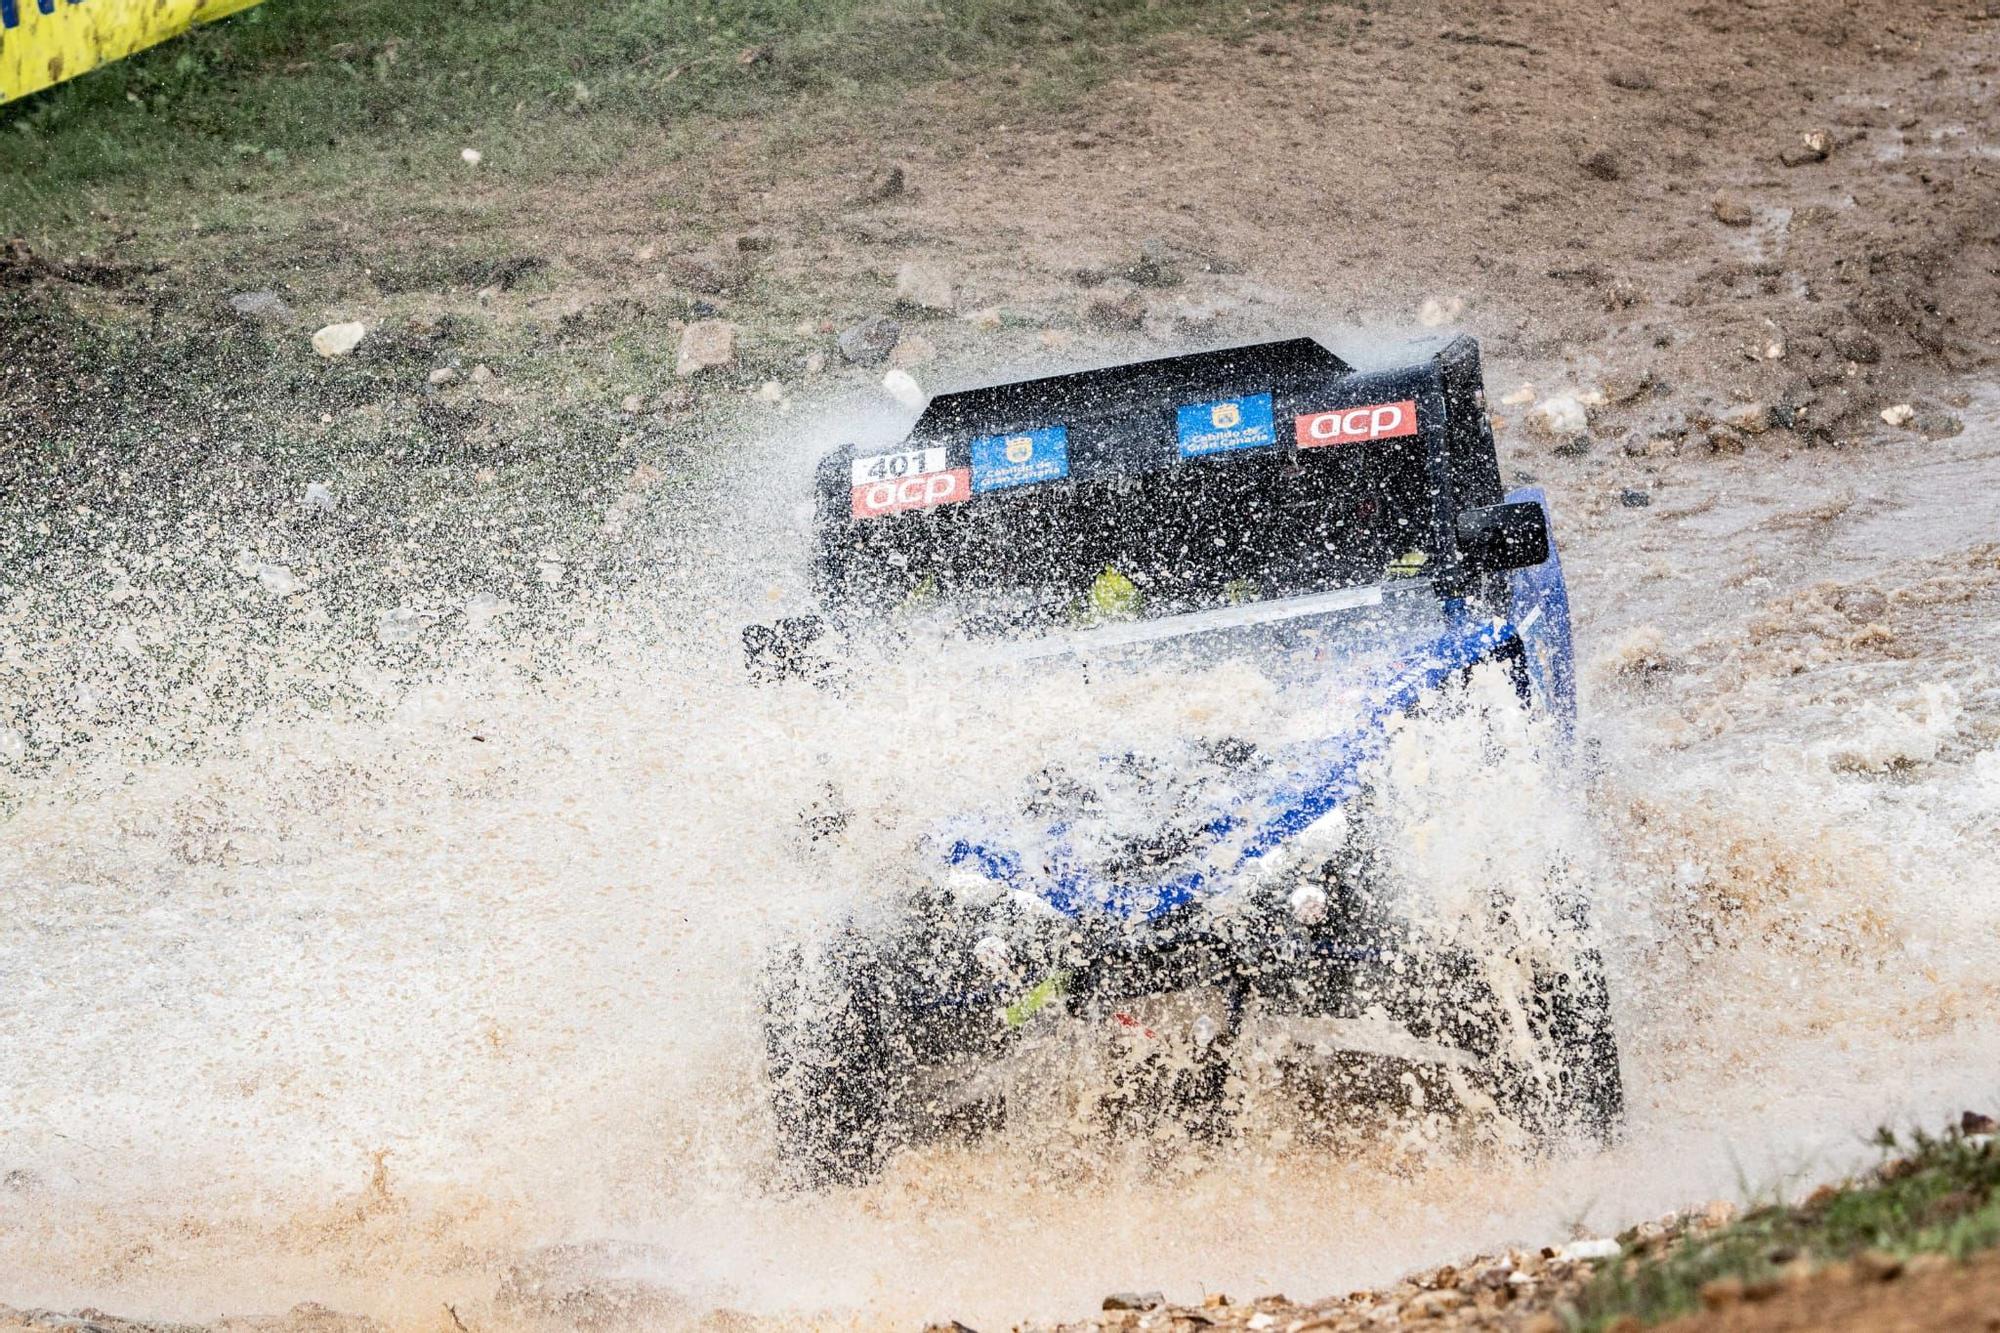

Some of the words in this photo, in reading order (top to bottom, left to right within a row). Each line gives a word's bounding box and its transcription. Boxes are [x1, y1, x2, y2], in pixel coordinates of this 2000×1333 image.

[1311, 406, 1402, 438] acp
[867, 453, 926, 479] 401
[866, 474, 956, 509] acp
